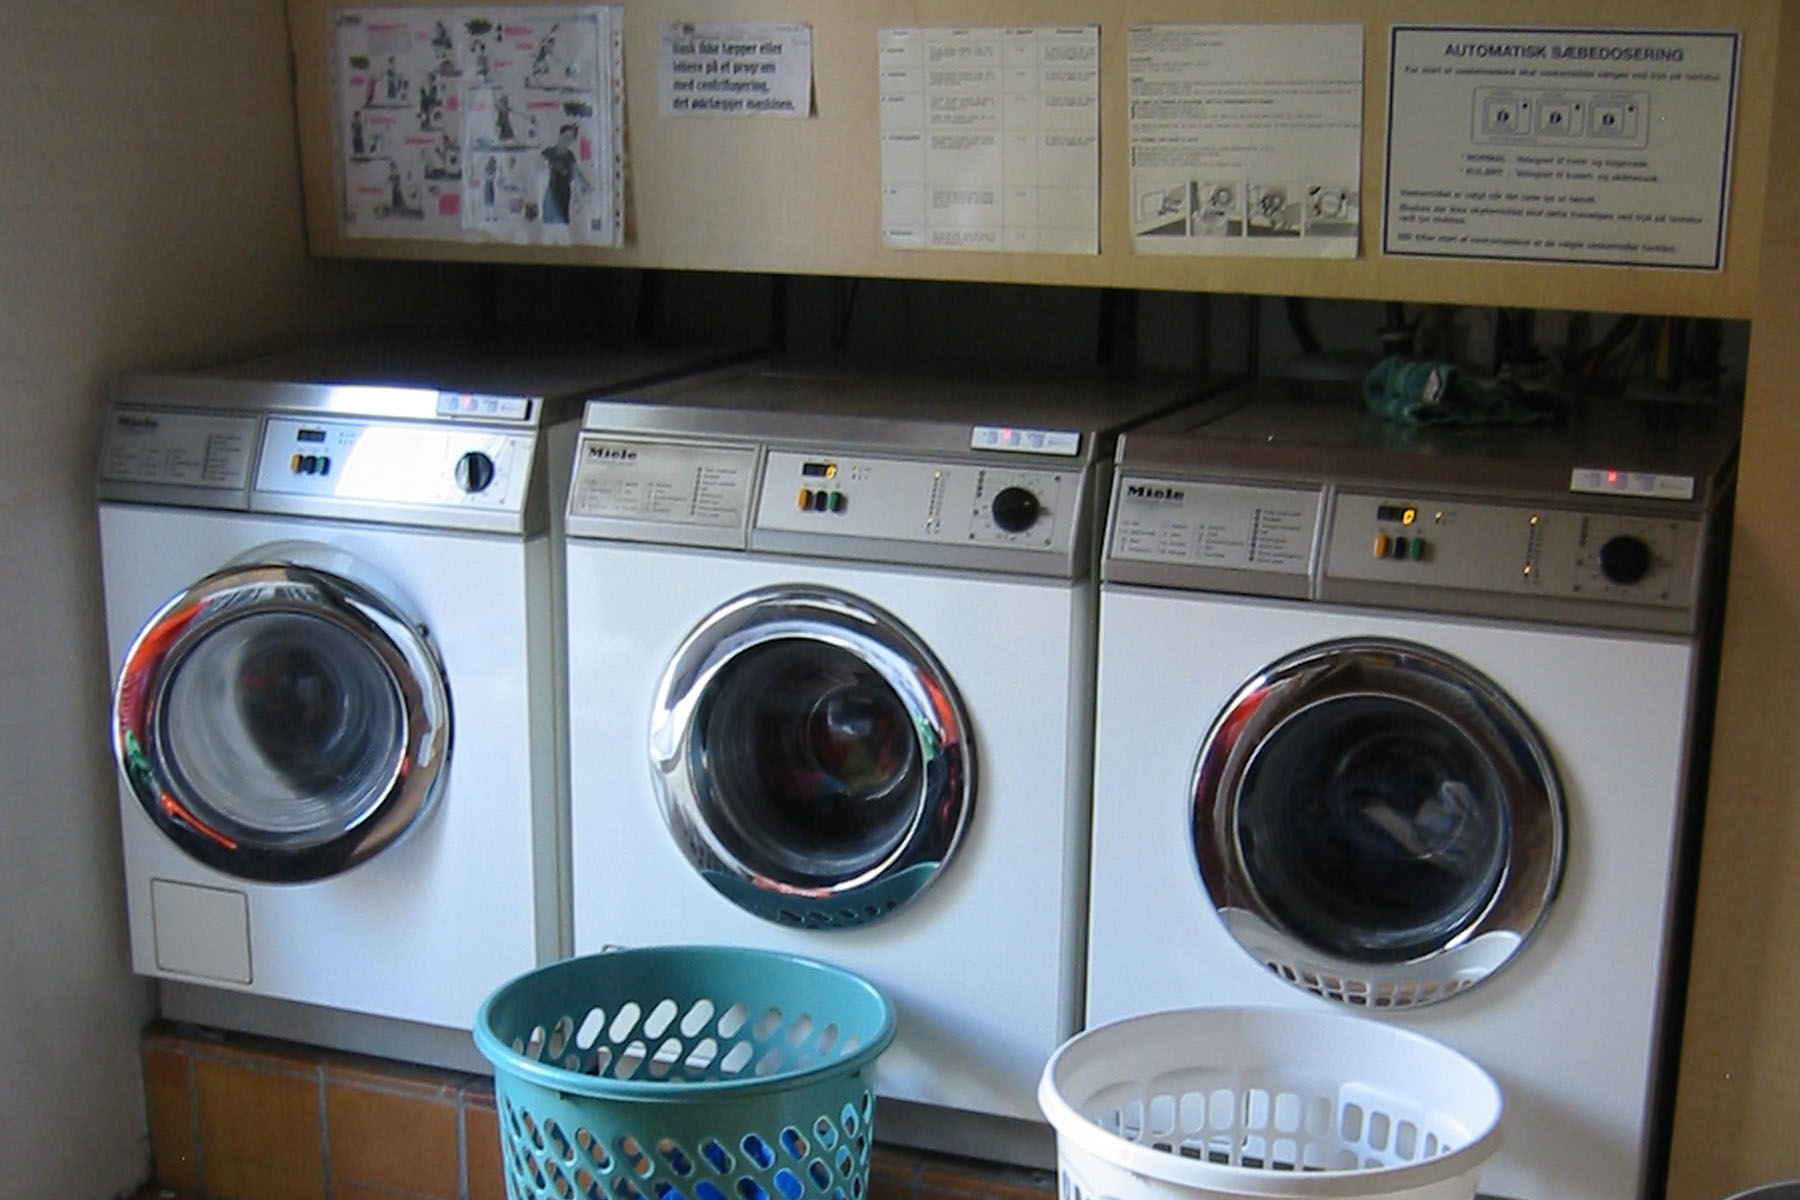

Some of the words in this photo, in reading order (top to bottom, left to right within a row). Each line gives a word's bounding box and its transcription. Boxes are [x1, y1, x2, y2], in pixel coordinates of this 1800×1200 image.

[1444, 43, 1546, 59] AUTOMATISK
[1551, 45, 1684, 61] SÆBEDOSERING
[589, 447, 637, 460] Miele
[1127, 485, 1184, 500] Miele
